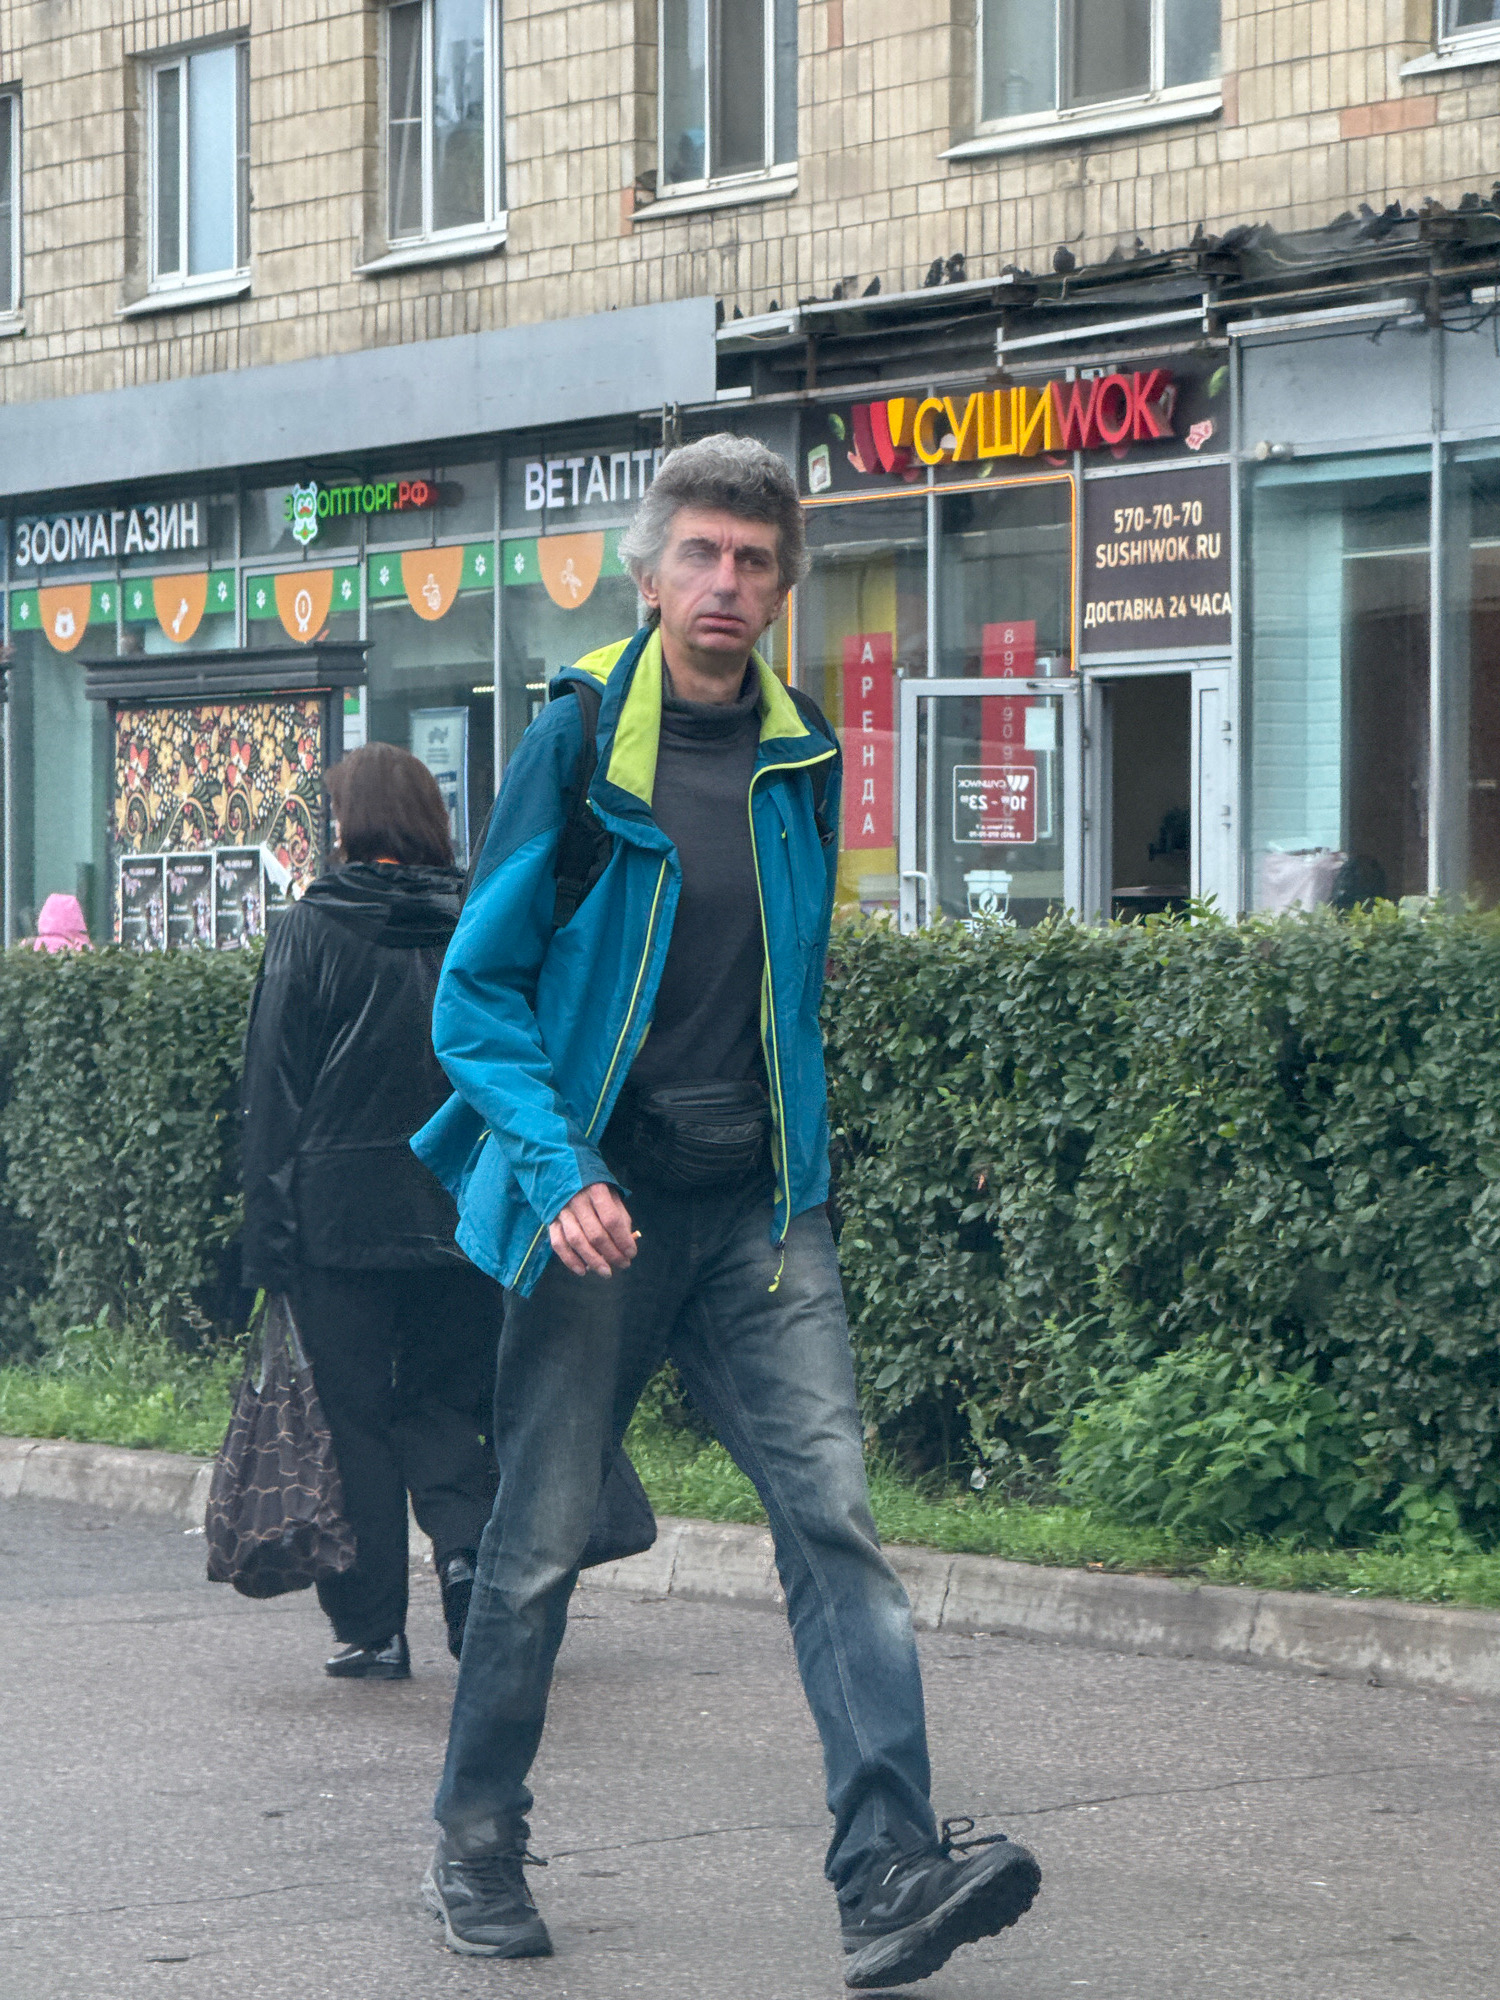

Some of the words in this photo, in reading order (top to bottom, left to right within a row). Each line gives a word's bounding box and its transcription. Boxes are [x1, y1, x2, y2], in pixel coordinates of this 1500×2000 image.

[914, 369, 1166, 465] СУШИWOK
[525, 447, 664, 511] ВЕТАПТ
[15, 502, 199, 567] ЗООМАГАЗИН
[1114, 500, 1203, 534] 570-70-70
[1095, 532, 1221, 569] SUSHIWOK.RU
[1084, 597, 1165, 629] ДОСТАВКА
[1169, 595, 1187, 618] 24
[1190, 592, 1233, 616] ЧАСА
[861, 641, 875, 835] АРЕНДА
